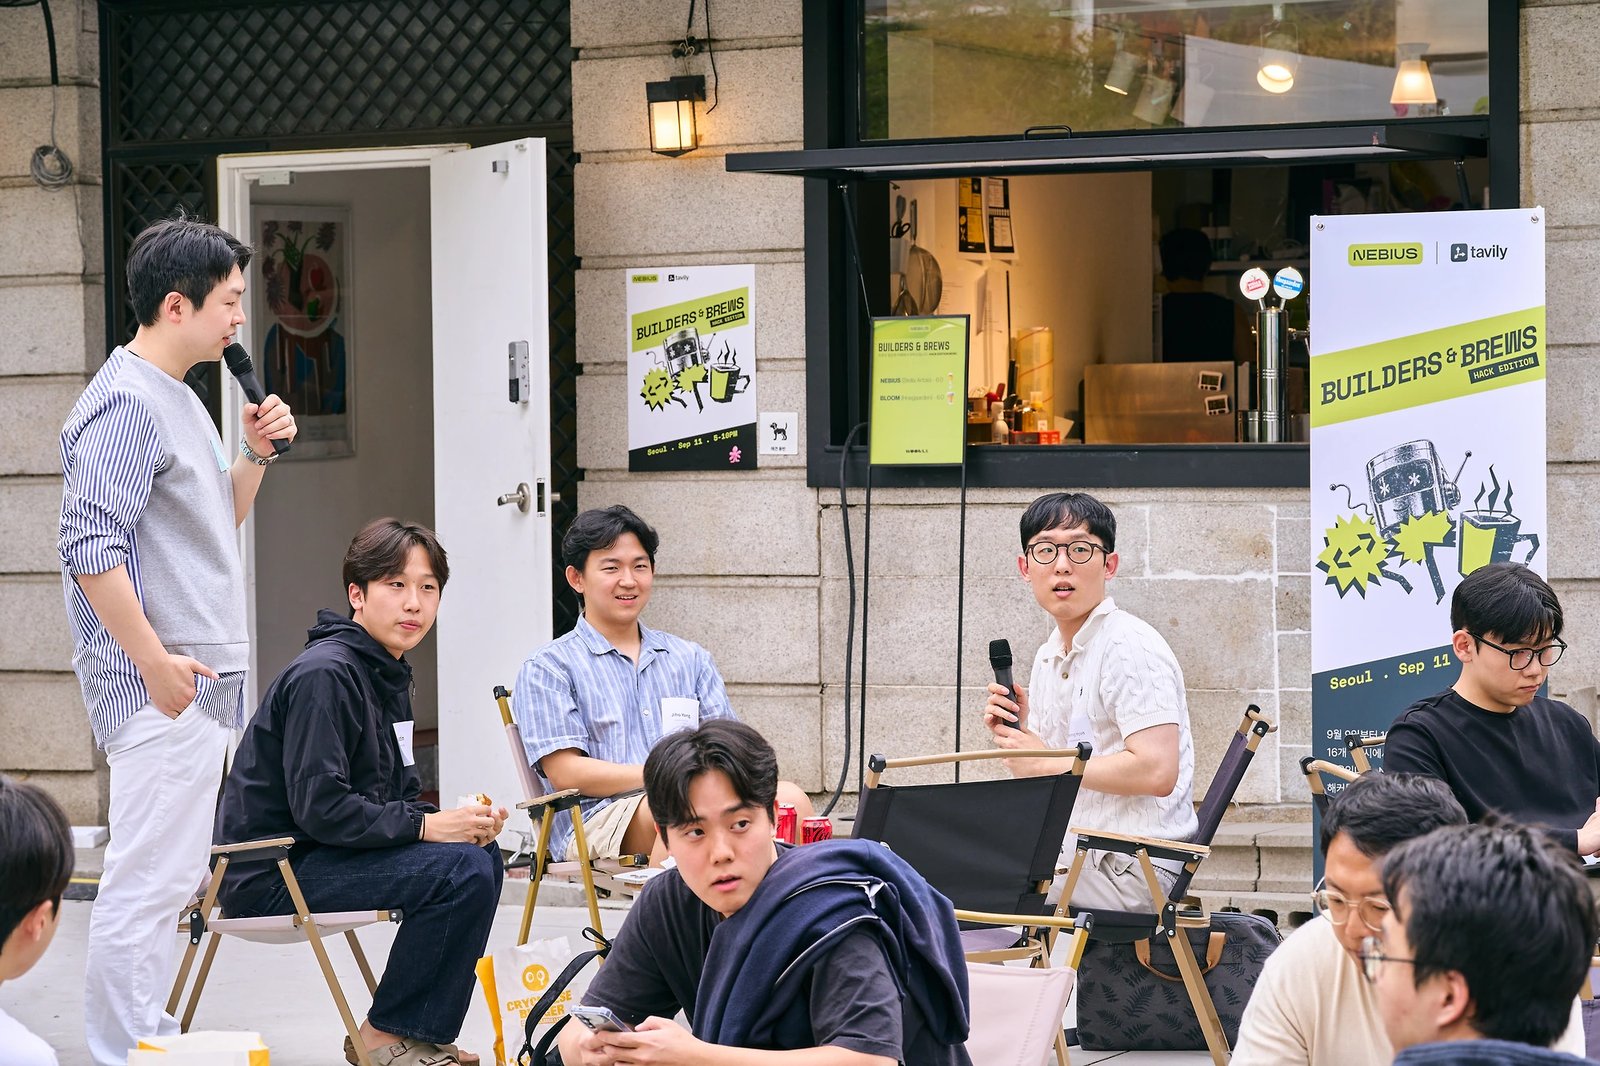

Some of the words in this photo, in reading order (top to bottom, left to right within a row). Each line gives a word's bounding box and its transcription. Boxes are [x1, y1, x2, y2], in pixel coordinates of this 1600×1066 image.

[1353, 247, 1418, 261] NEBIUS
[1471, 244, 1508, 261] tavily
[636, 311, 697, 340] BUILDERS
[698, 308, 704, 317] &
[706, 296, 744, 319] BREWS
[878, 342, 914, 352] BUILDERS
[916, 342, 921, 351] &
[923, 341, 950, 351] BREWS
[1320, 351, 1442, 406] BUILDERS
[1446, 347, 1458, 364] &
[1460, 325, 1538, 368] BREWS
[1473, 368, 1495, 380] HACK
[1498, 357, 1536, 373] EDITION
[647, 445, 668, 456] Seoul
[678, 441, 691, 449] Sep
[694, 438, 703, 446] 11
[713, 430, 738, 442] 5-10PM
[1329, 670, 1373, 690] Seoul
[1398, 660, 1425, 676] Sep
[1433, 653, 1451, 669] 11
[1326, 729, 1342, 740] 9월
[1326, 747, 1347, 758] 16개
